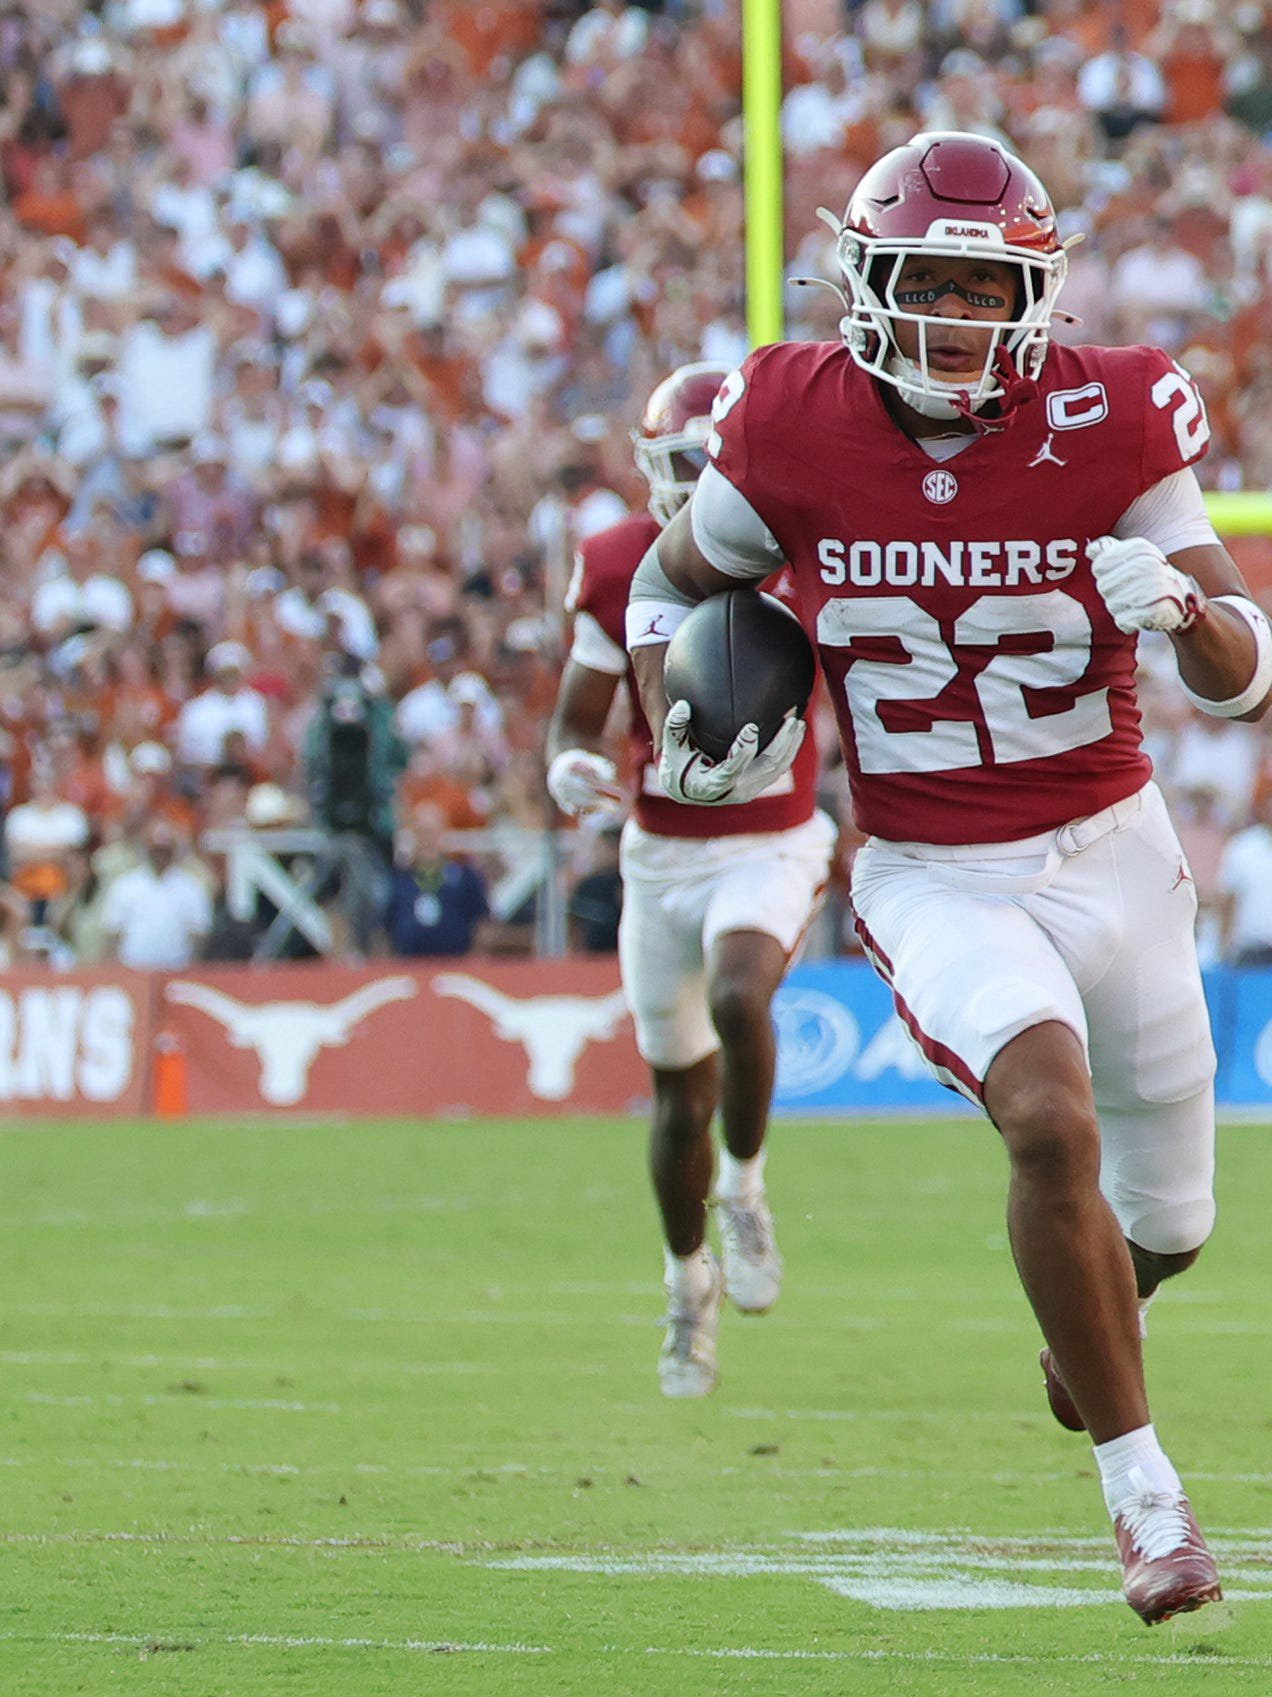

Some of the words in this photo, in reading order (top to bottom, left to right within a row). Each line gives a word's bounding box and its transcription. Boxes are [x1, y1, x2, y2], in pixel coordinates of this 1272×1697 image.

[944, 226, 989, 239] OKLAHOMA
[1052, 387, 1103, 423] C
[926, 473, 955, 500] SEC
[817, 539, 1077, 587] SOONERS
[816, 589, 1114, 775] 22
